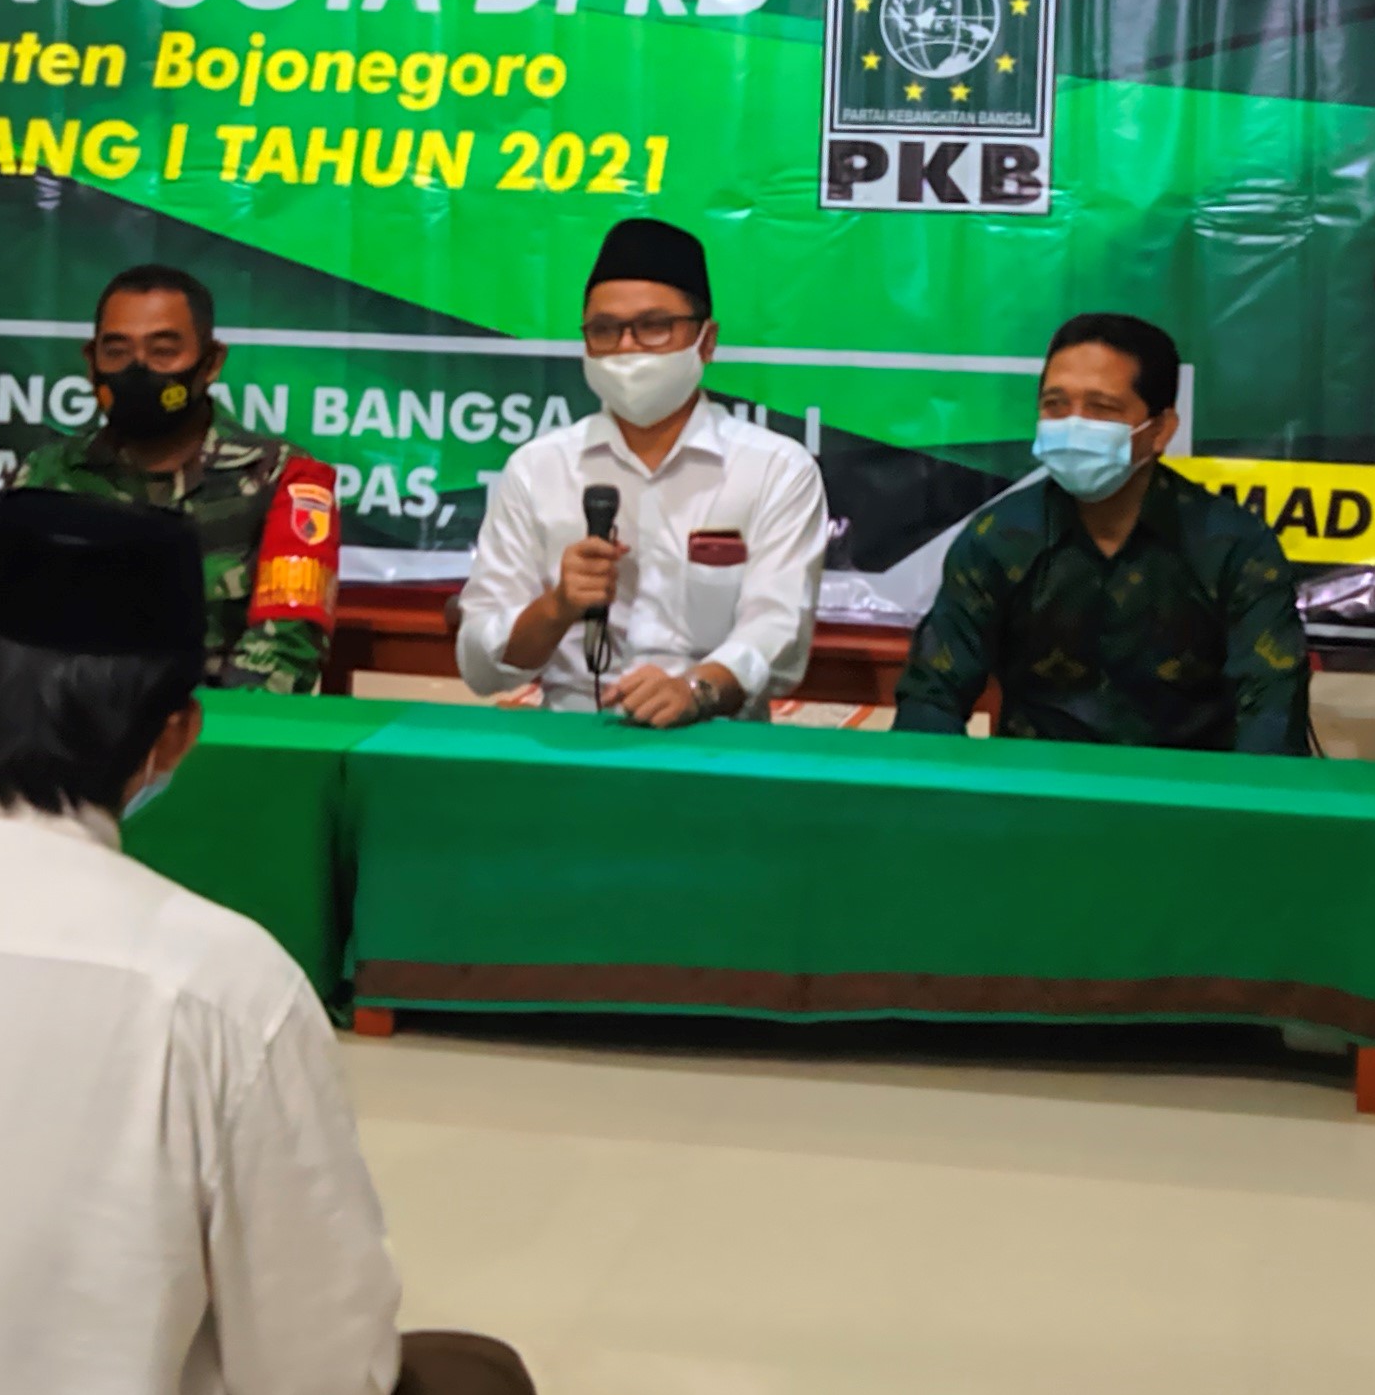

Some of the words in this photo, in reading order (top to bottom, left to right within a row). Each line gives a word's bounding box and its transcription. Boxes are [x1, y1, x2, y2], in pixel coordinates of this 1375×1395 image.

[152, 30, 567, 112] Bojonegoro
[841, 107, 886, 123] PARTAI
[978, 110, 1033, 126] BANGSA
[164, 123, 189, 181] I
[215, 124, 475, 189] TAHUN
[496, 130, 669, 195] 2021
[826, 138, 1043, 205] PKB
[312, 386, 572, 444] BANGSA
